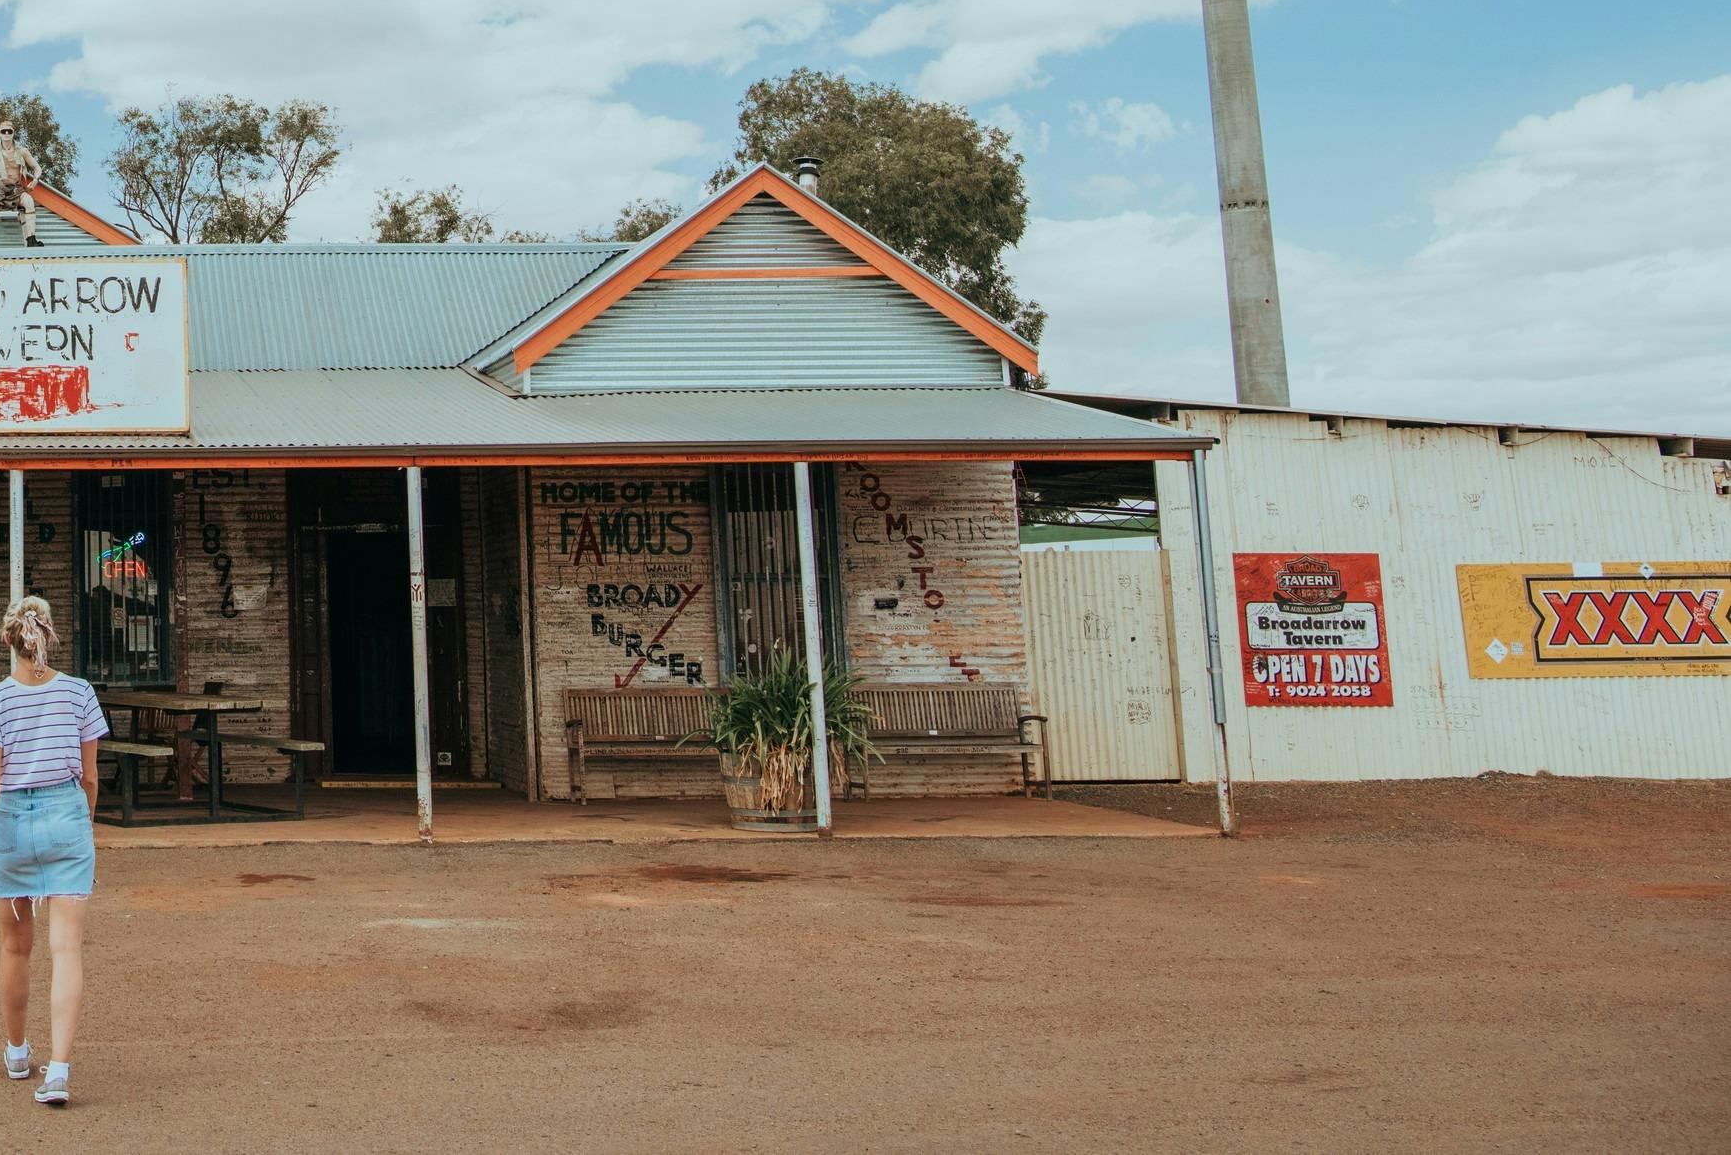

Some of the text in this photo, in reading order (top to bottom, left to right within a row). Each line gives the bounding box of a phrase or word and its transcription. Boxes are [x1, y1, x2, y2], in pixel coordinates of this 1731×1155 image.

[22, 276, 162, 315] ARROW
[540, 481, 709, 503] HOME OF THE
[558, 507, 694, 567] FAMOUS
[102, 560, 147, 578] OPEN
[1293, 562, 1322, 572] BROAD
[1282, 575, 1334, 586] TAVERN
[1257, 616, 1366, 630] Broadarrow
[1541, 591, 1730, 645] XXXX
[1283, 632, 1343, 645] Tavern
[590, 613, 706, 685] BURGER
[1252, 654, 1382, 683] OPEN 7 DAYS
[1266, 685, 1372, 697] T: 9024 2058
